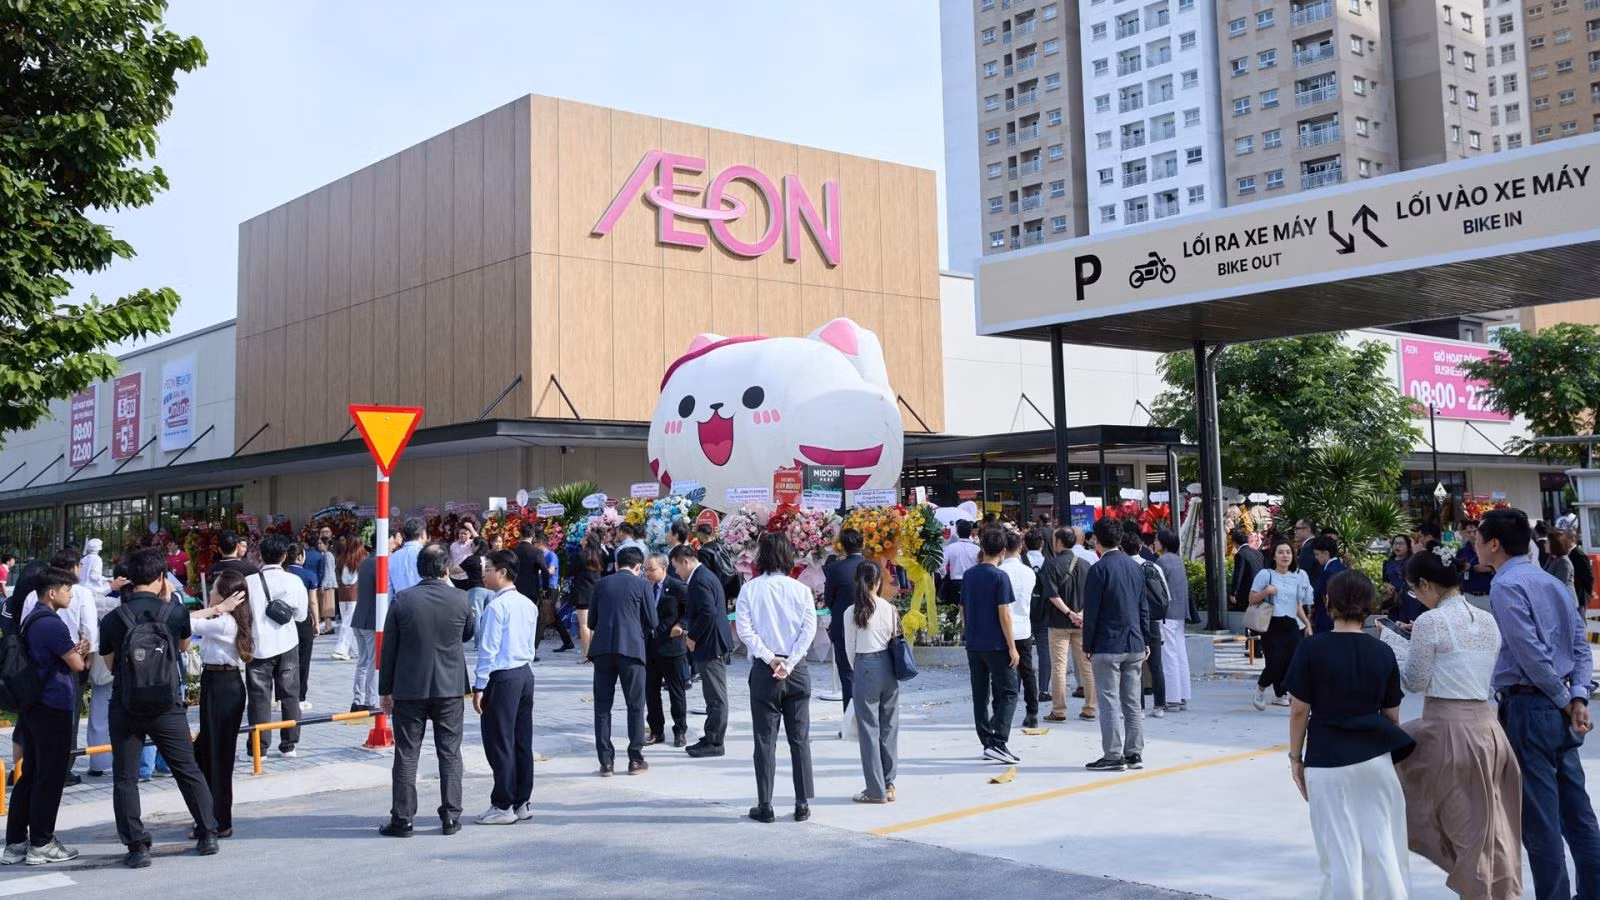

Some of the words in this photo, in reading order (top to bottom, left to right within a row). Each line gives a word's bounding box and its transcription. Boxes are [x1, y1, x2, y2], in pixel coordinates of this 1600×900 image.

[1395, 190, 1431, 220] LỐI
[1436, 184, 1488, 212] VÀO
[1494, 177, 1526, 203] XE
[1532, 164, 1591, 195] MÁY
[1463, 214, 1501, 235] BIKE
[1504, 210, 1523, 228] IN
[1183, 232, 1211, 258] LỐI
[1215, 232, 1241, 253] RA
[1244, 226, 1269, 247] XE
[1273, 214, 1317, 243] MÁY
[1217, 258, 1249, 276] BIKE
[1251, 252, 1282, 271] OUT
[1074, 254, 1103, 301] P
[72, 421, 93, 442] 08:00
[72, 442, 92, 462] 22:00
[813, 469, 840, 477] MIDORI
